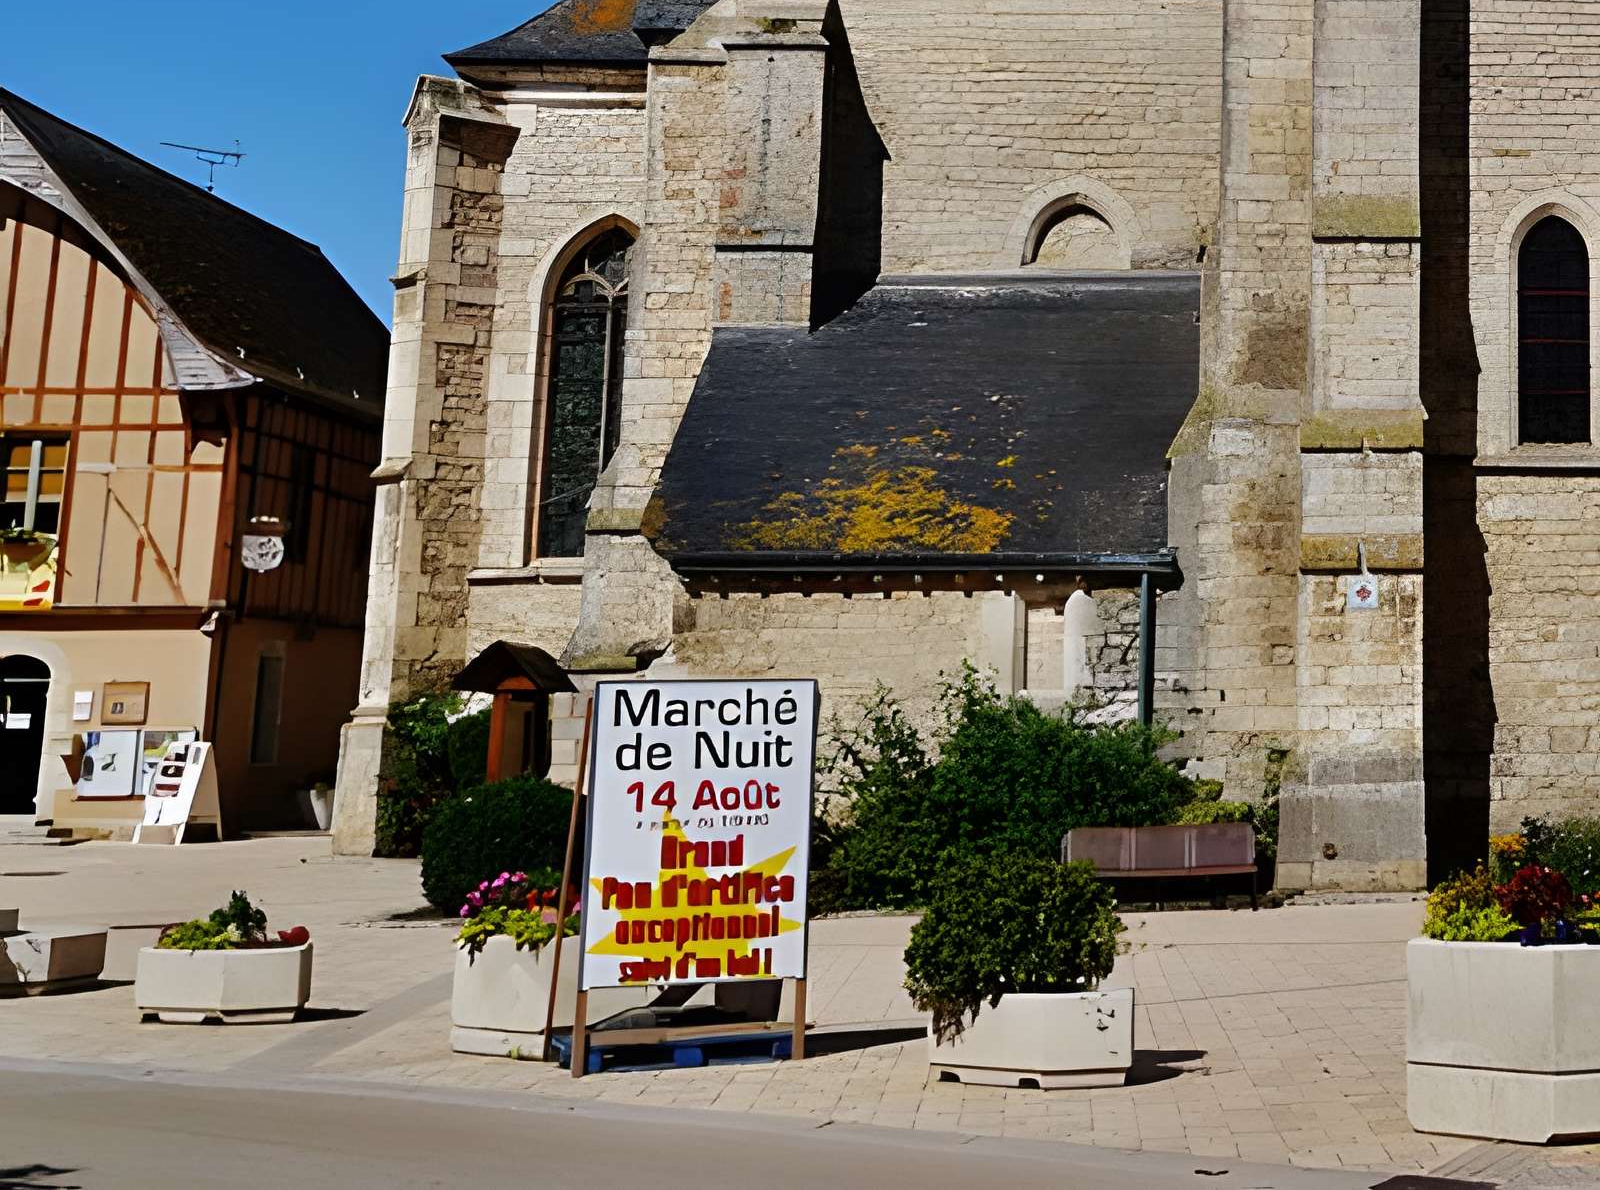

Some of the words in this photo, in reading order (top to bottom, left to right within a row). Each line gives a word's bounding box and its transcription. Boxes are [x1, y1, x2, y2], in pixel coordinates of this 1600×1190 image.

[613, 688, 798, 727] Marché
[615, 732, 672, 771] de
[694, 729, 793, 770] Nuit
[626, 780, 678, 813] 14
[692, 778, 781, 811] Août
